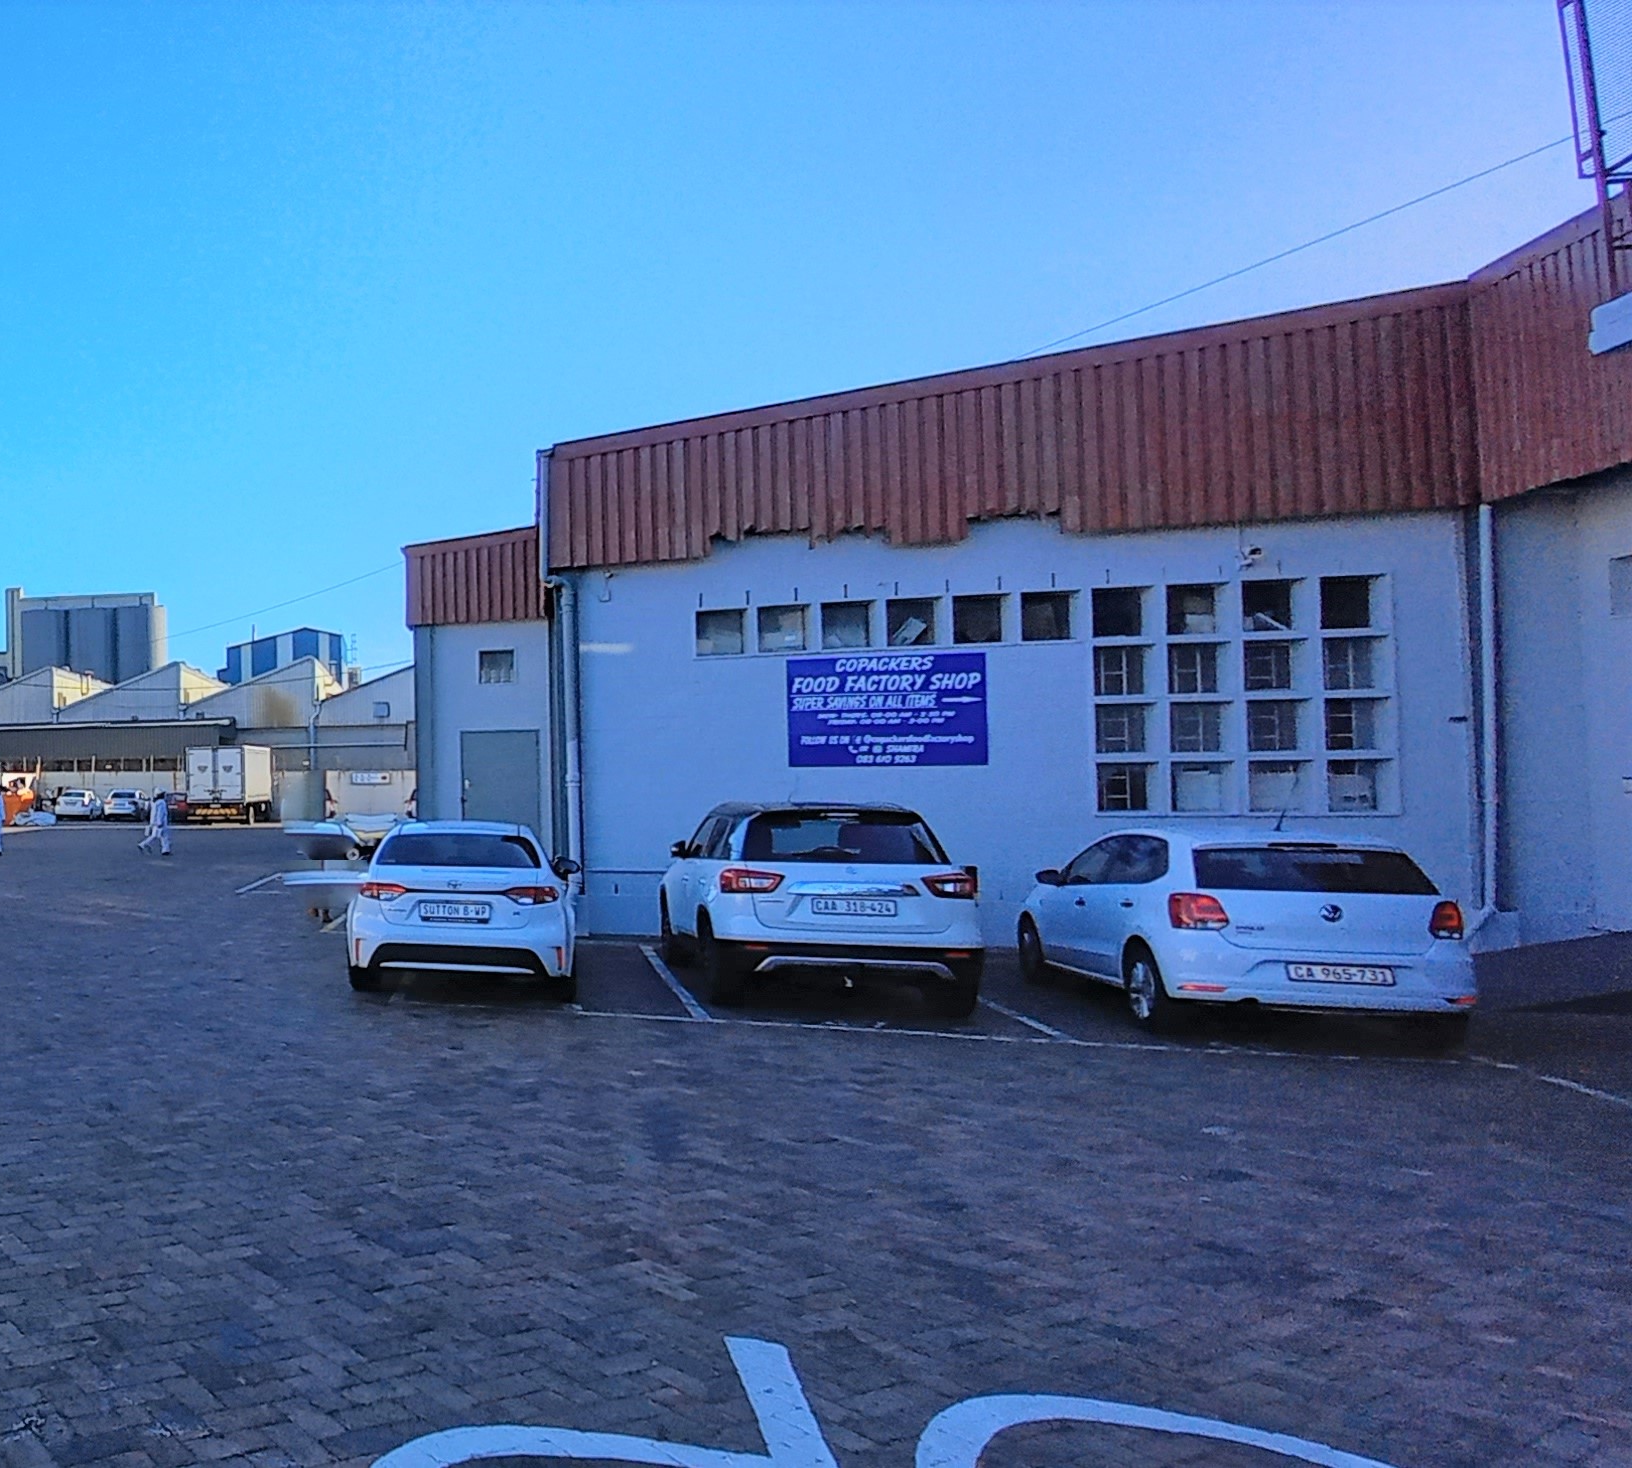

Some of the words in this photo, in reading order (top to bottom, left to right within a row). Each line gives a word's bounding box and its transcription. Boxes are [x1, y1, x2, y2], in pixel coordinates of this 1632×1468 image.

[835, 655, 934, 673] COPACKERS
[792, 676, 840, 694] FOOD
[844, 673, 926, 693] FACTORY
[929, 672, 981, 690] SHOP
[792, 697, 825, 710] SUPER
[826, 695, 868, 709] SAVINGS
[868, 695, 885, 708] ON
[885, 695, 903, 708] ALL
[904, 694, 937, 708] ITEMS
[423, 904, 460, 915] SUTTON
[815, 900, 838, 911] CAA
[1294, 966, 1316, 979] CA
[1321, 968, 1390, 984] 965-731
